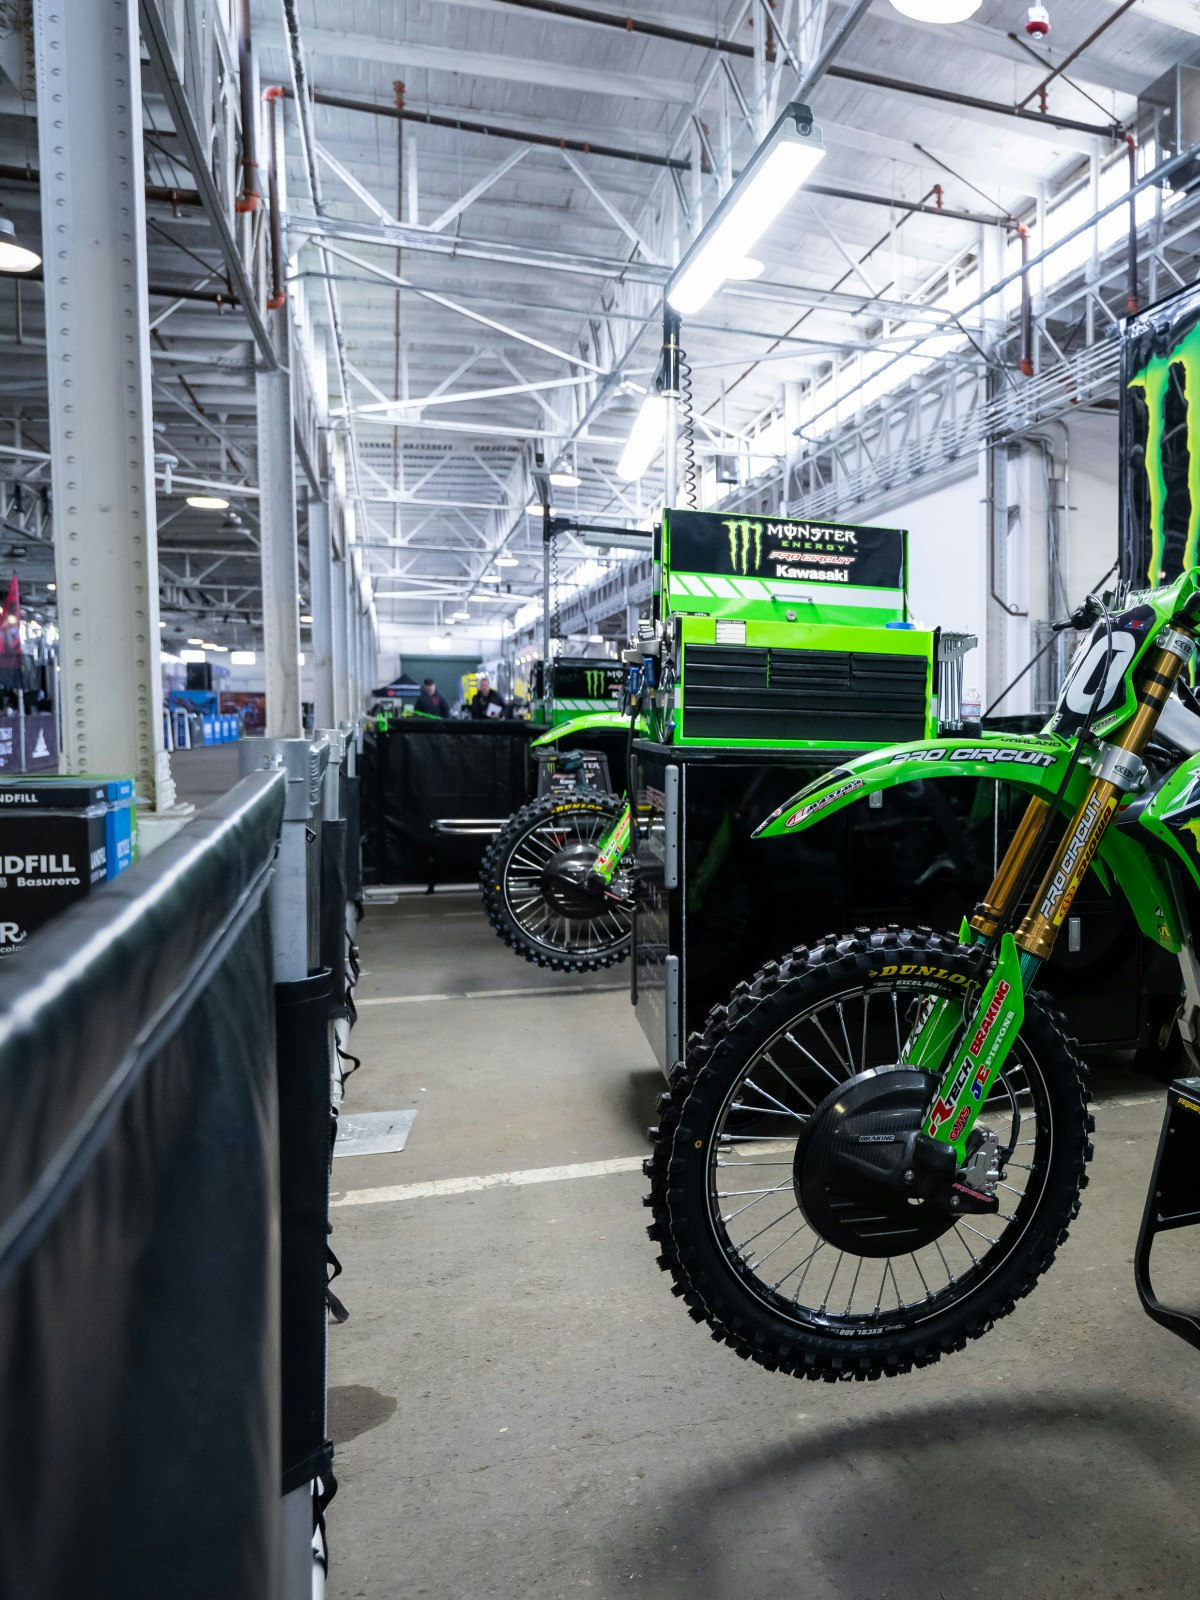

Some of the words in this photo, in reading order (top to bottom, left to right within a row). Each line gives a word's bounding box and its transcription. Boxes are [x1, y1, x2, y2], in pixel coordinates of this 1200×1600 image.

[766, 523, 858, 544] MONSTER
[781, 540, 845, 552] ENERGY
[767, 550, 802, 562] PRO
[800, 553, 856, 565] CIRCUIT
[775, 564, 849, 582] Kawasaki
[1001, 738, 1062, 747] VOHLAND
[887, 748, 948, 764] PRO
[948, 748, 1057, 768] CIRCUIT
[1076, 805, 1112, 882] SHOWA
[1039, 870, 1068, 919] PRO
[1060, 791, 1102, 876] CIRCUIT
[17, 877, 81, 888] Basurero
[896, 979, 922, 987] EXCEL
[968, 979, 1011, 1058] BRAKING
[986, 1011, 1015, 1066] PISTONS
[970, 1064, 991, 1102] JE
[859, 1134, 895, 1143] BRAKING
